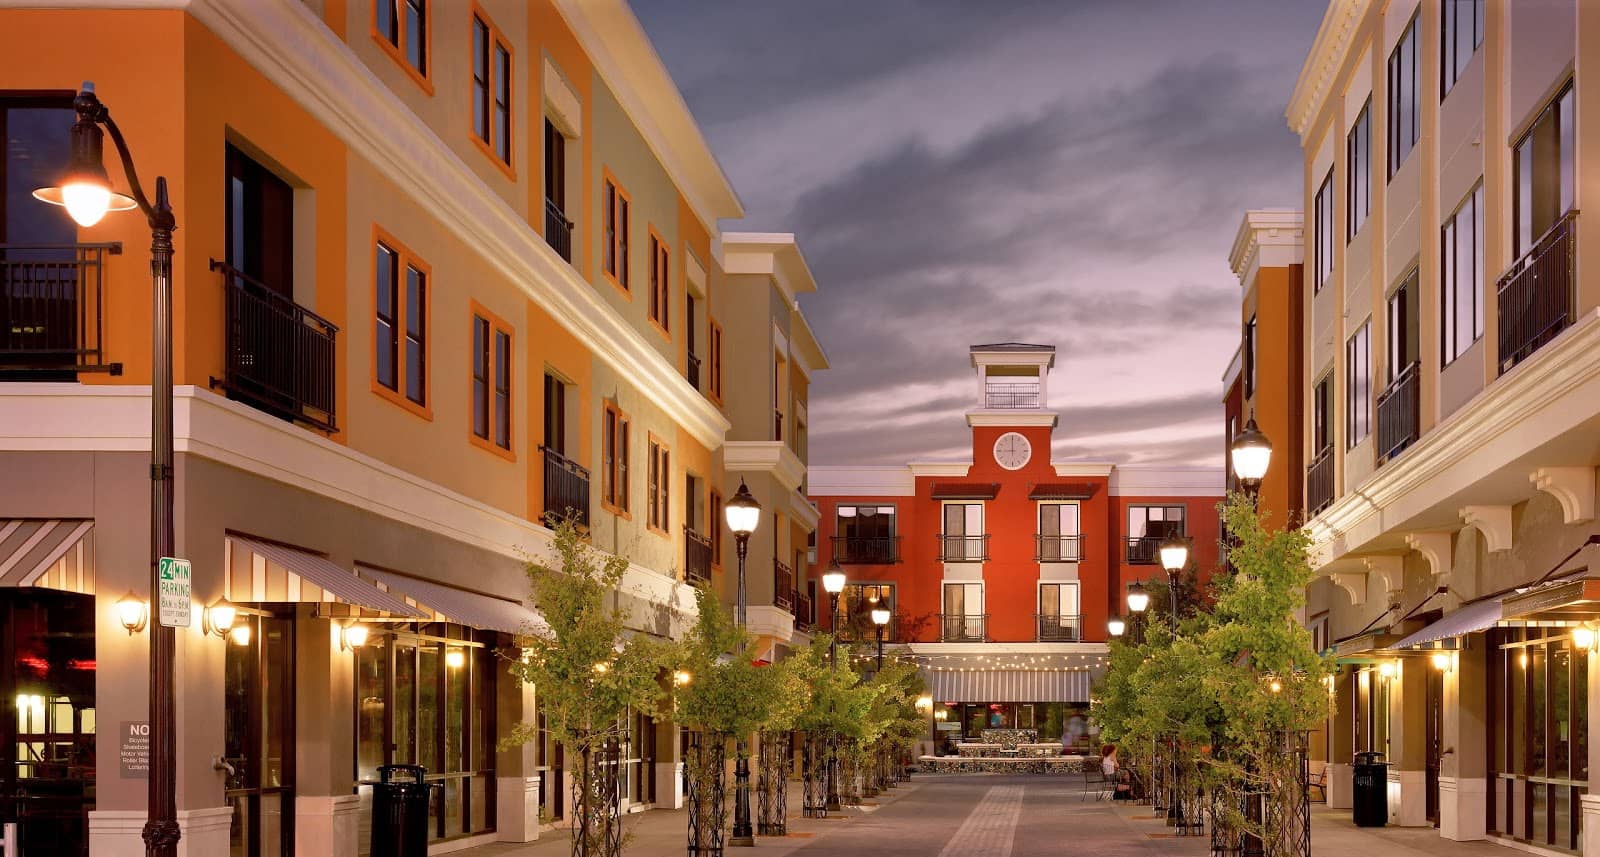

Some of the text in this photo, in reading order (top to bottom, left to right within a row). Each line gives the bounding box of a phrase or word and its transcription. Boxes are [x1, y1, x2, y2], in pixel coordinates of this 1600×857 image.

[161, 561, 188, 580] 24 MIN
[161, 582, 189, 598] PARKING
[130, 724, 149, 735] NO
